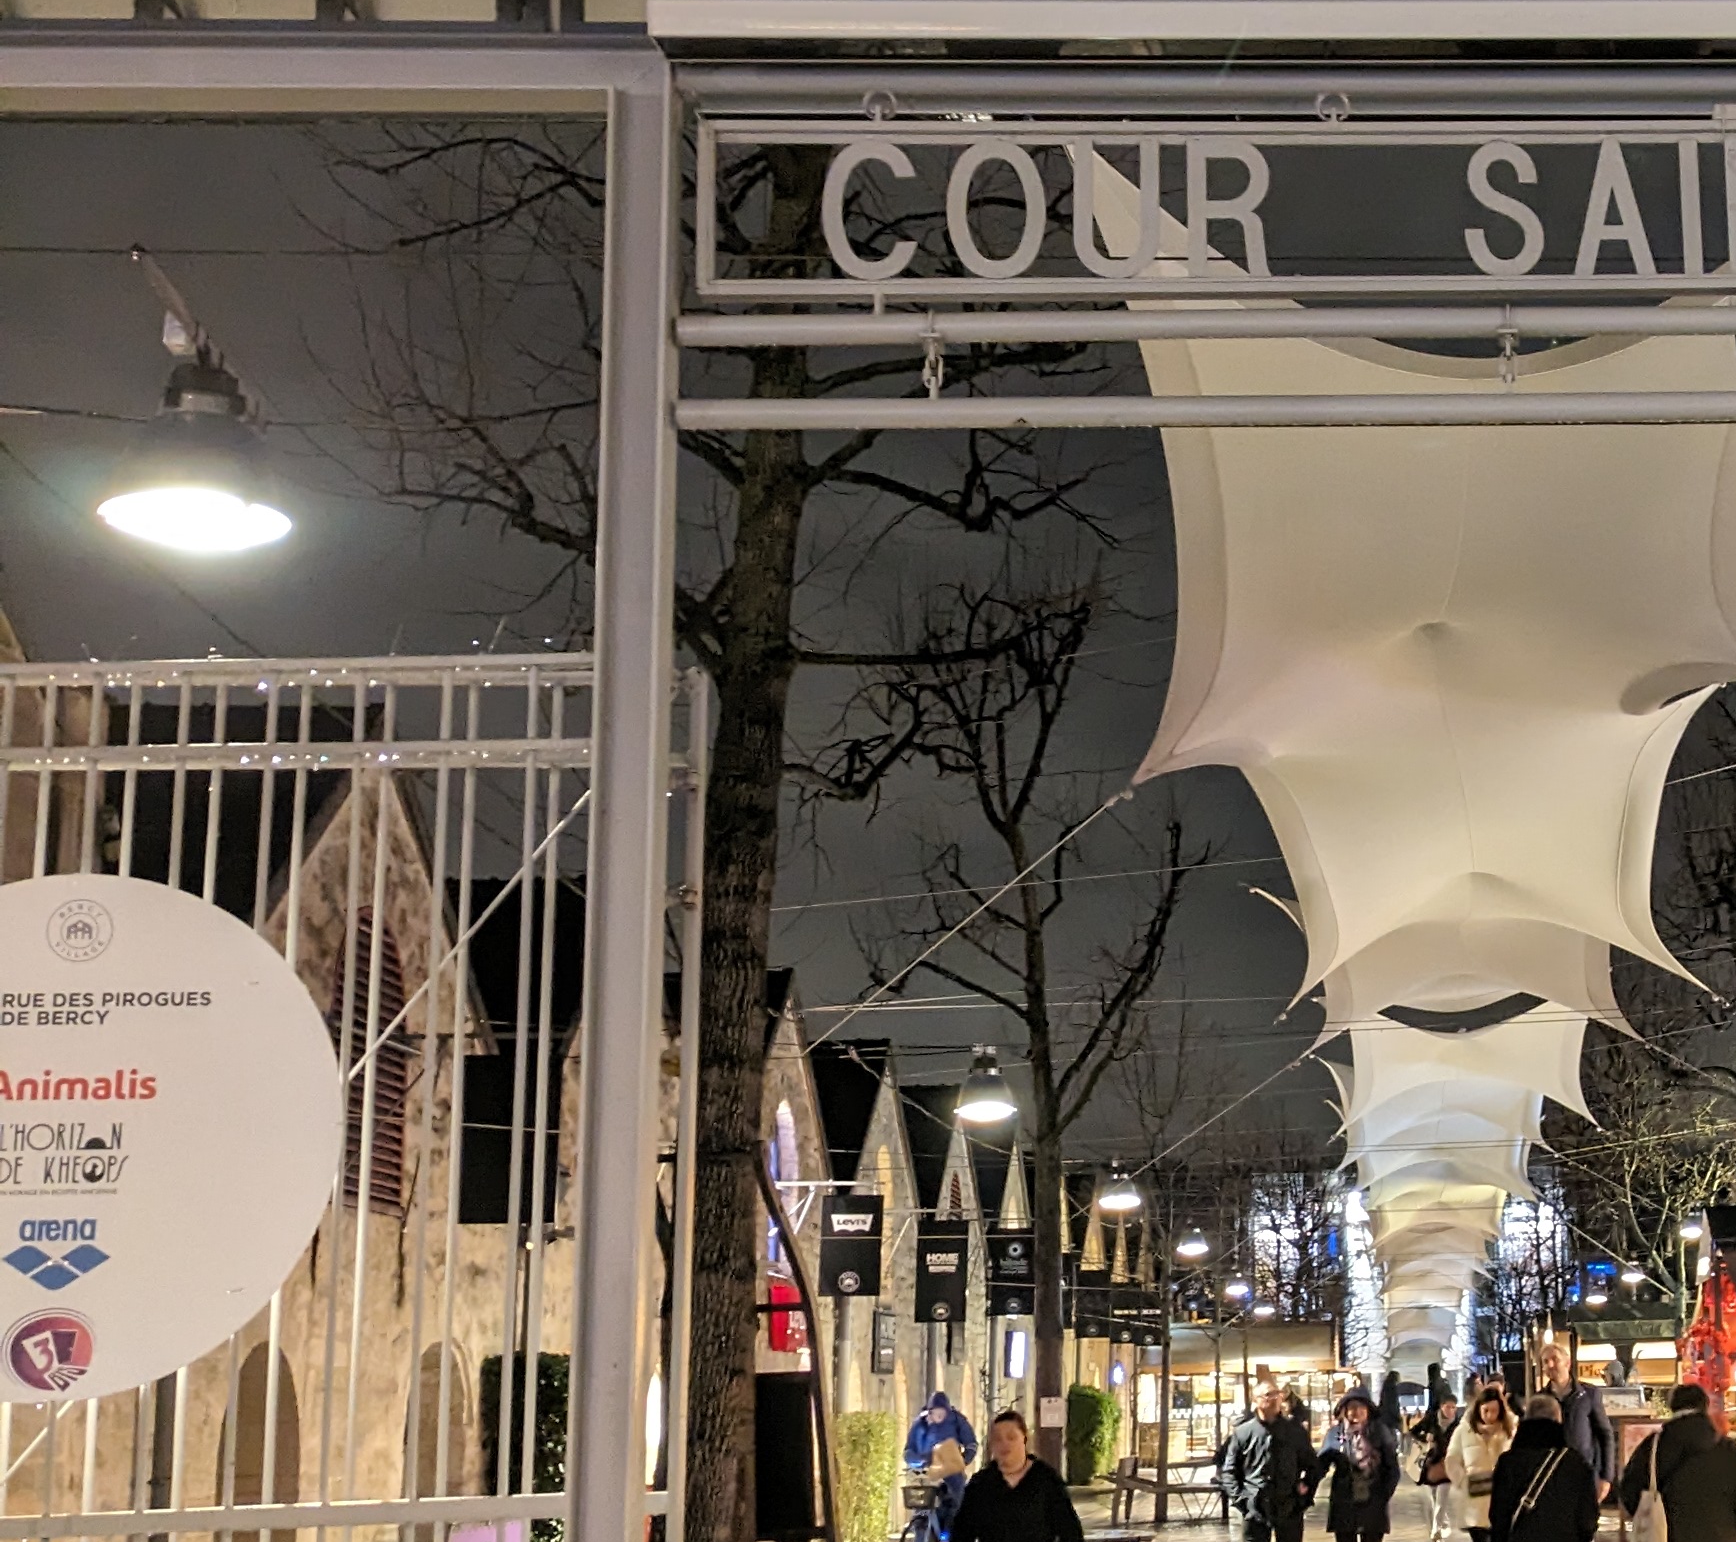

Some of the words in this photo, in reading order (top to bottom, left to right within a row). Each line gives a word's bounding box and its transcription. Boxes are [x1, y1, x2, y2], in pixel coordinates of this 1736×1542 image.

[822, 138, 1271, 280] COUR
[2, 992, 46, 1008] RUE
[52, 992, 94, 1007] DES
[101, 990, 212, 1007] PIROGUES
[0, 1011, 30, 1026] DE
[36, 1009, 110, 1026] BERCY
[0, 1068, 157, 1101] Animalis
[0, 1156, 24, 1185] DE
[43, 1155, 130, 1185] KHEOPS
[19, 1218, 97, 1242] arena
